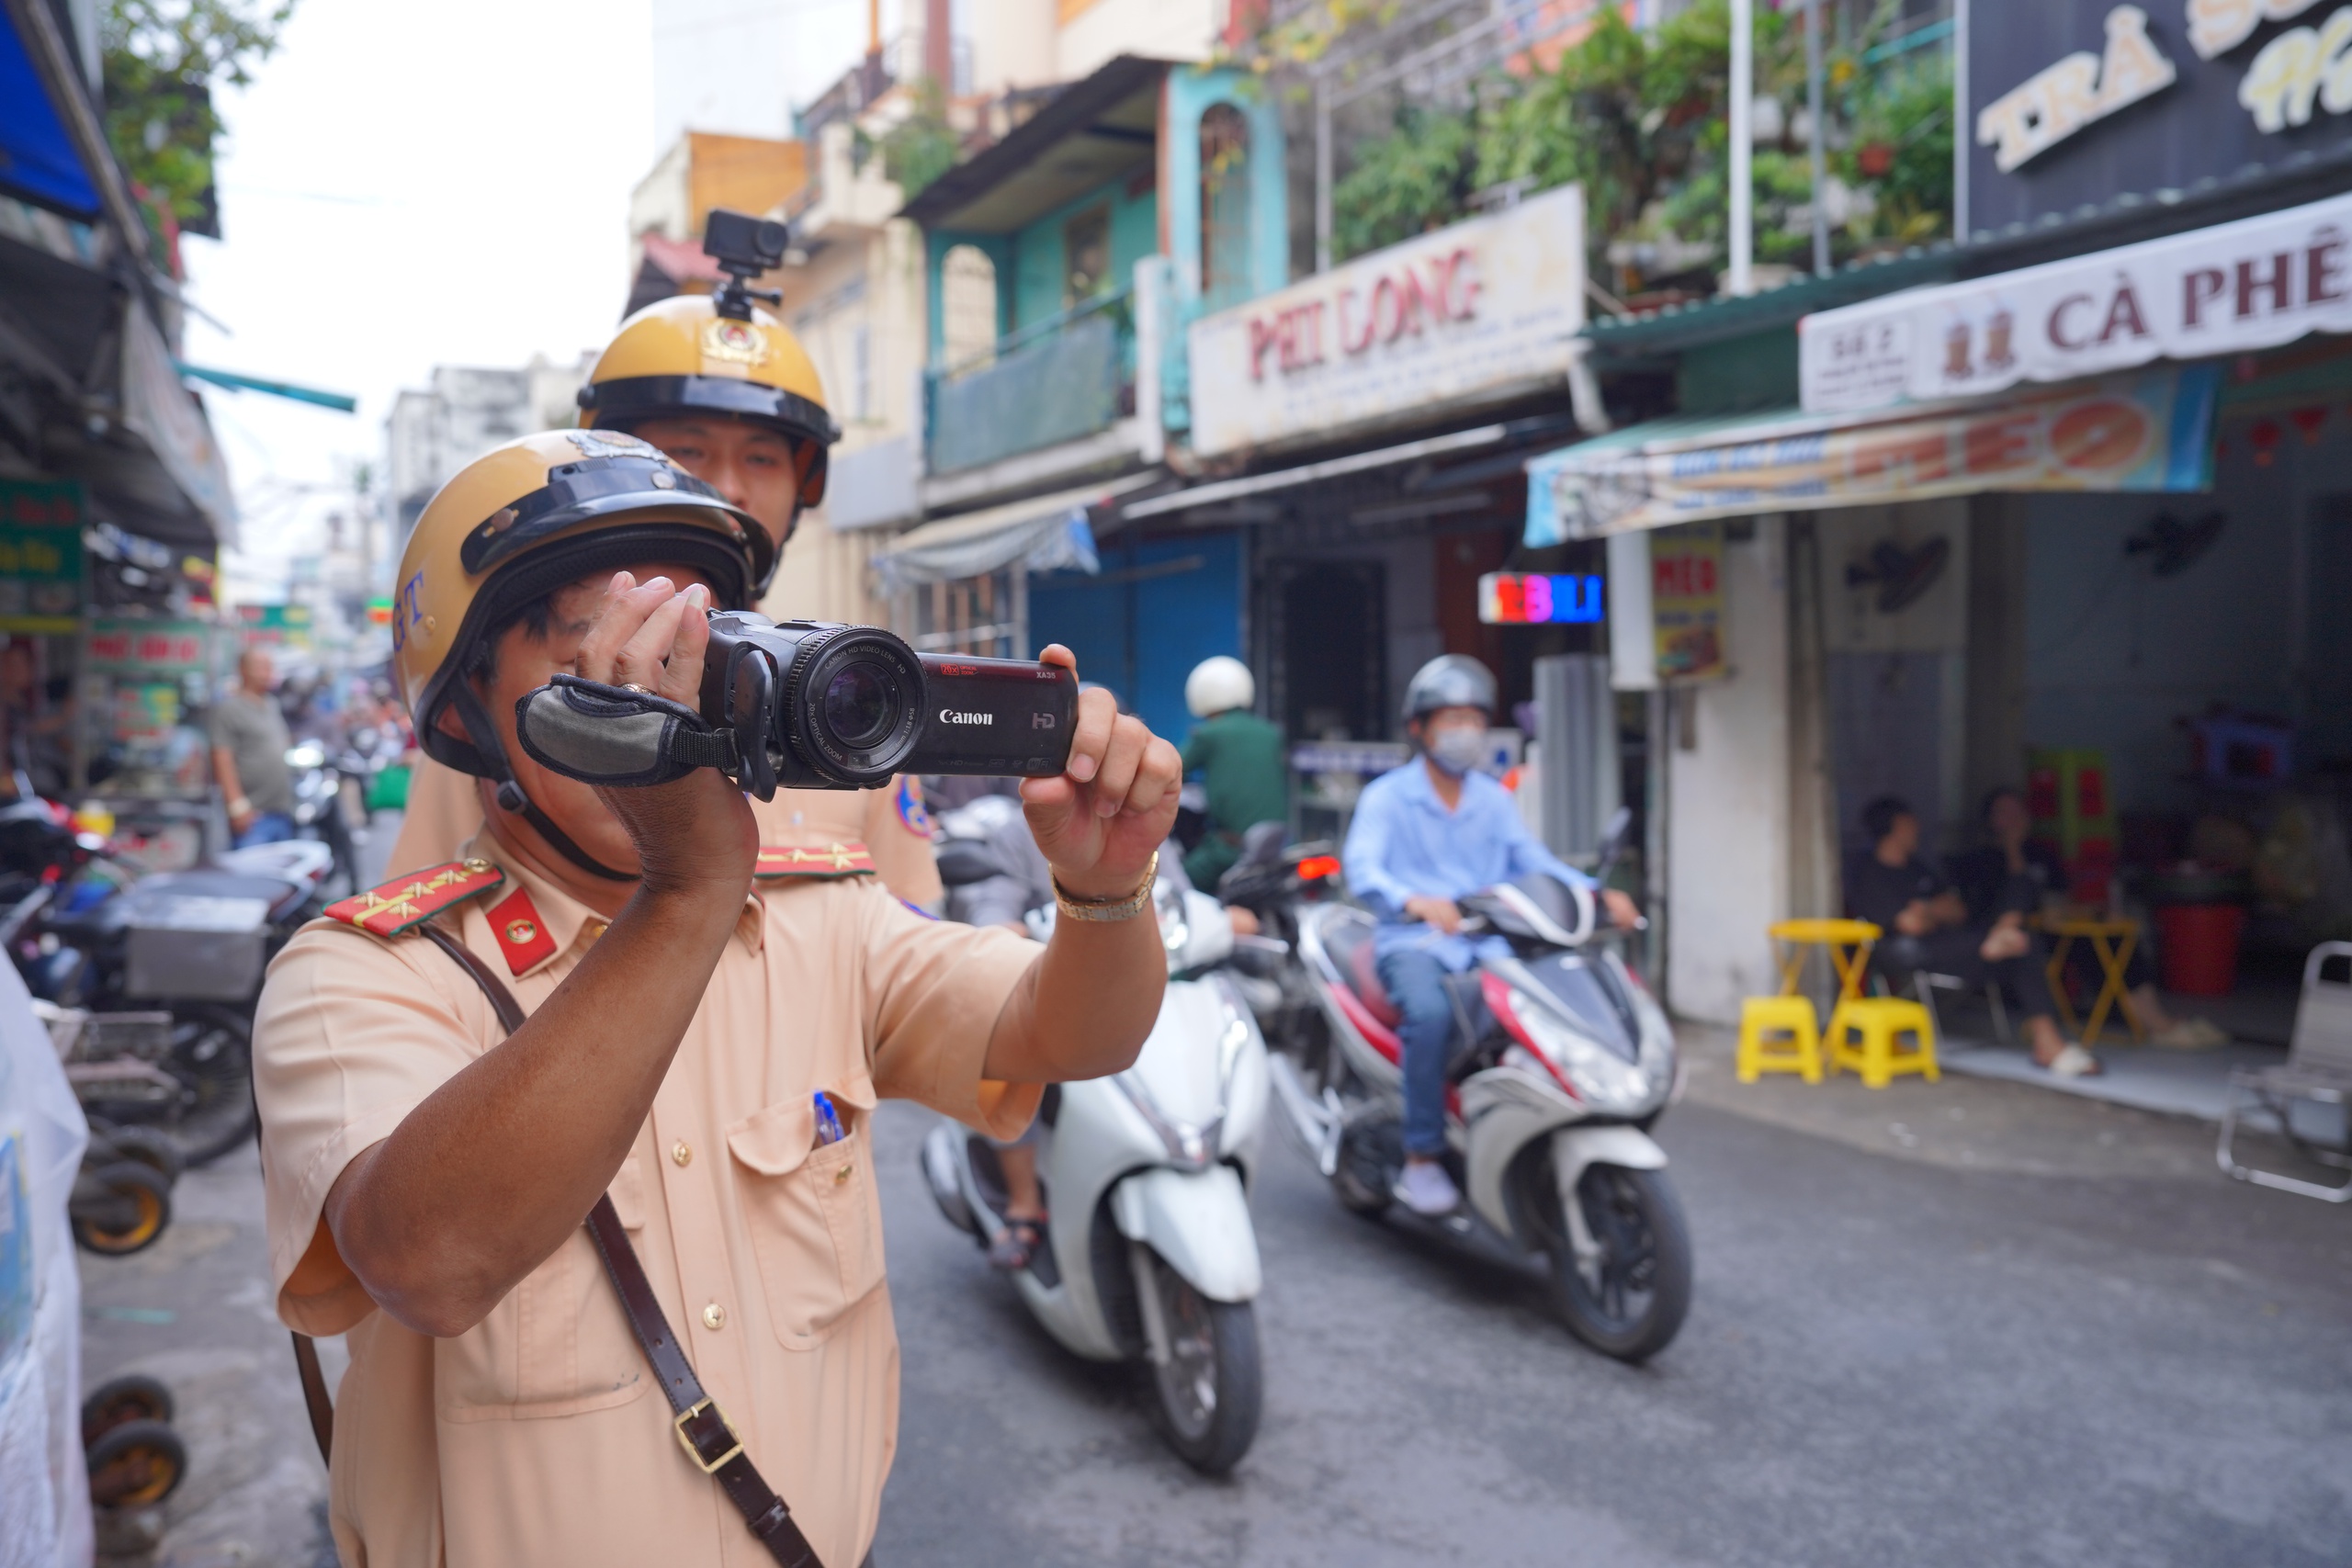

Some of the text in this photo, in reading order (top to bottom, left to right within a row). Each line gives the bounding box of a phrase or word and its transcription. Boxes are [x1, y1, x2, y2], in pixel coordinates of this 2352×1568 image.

[1338, 247, 1482, 355] LONG
[2046, 226, 2350, 352] CÀ PHÊ
[824, 645, 897, 670] CANON HD VIDEO LENS
[939, 709, 993, 725] Canon
[1032, 712, 1056, 730] HD
[810, 717, 825, 747] OPTICAL
[823, 745, 843, 761] ZOOM
